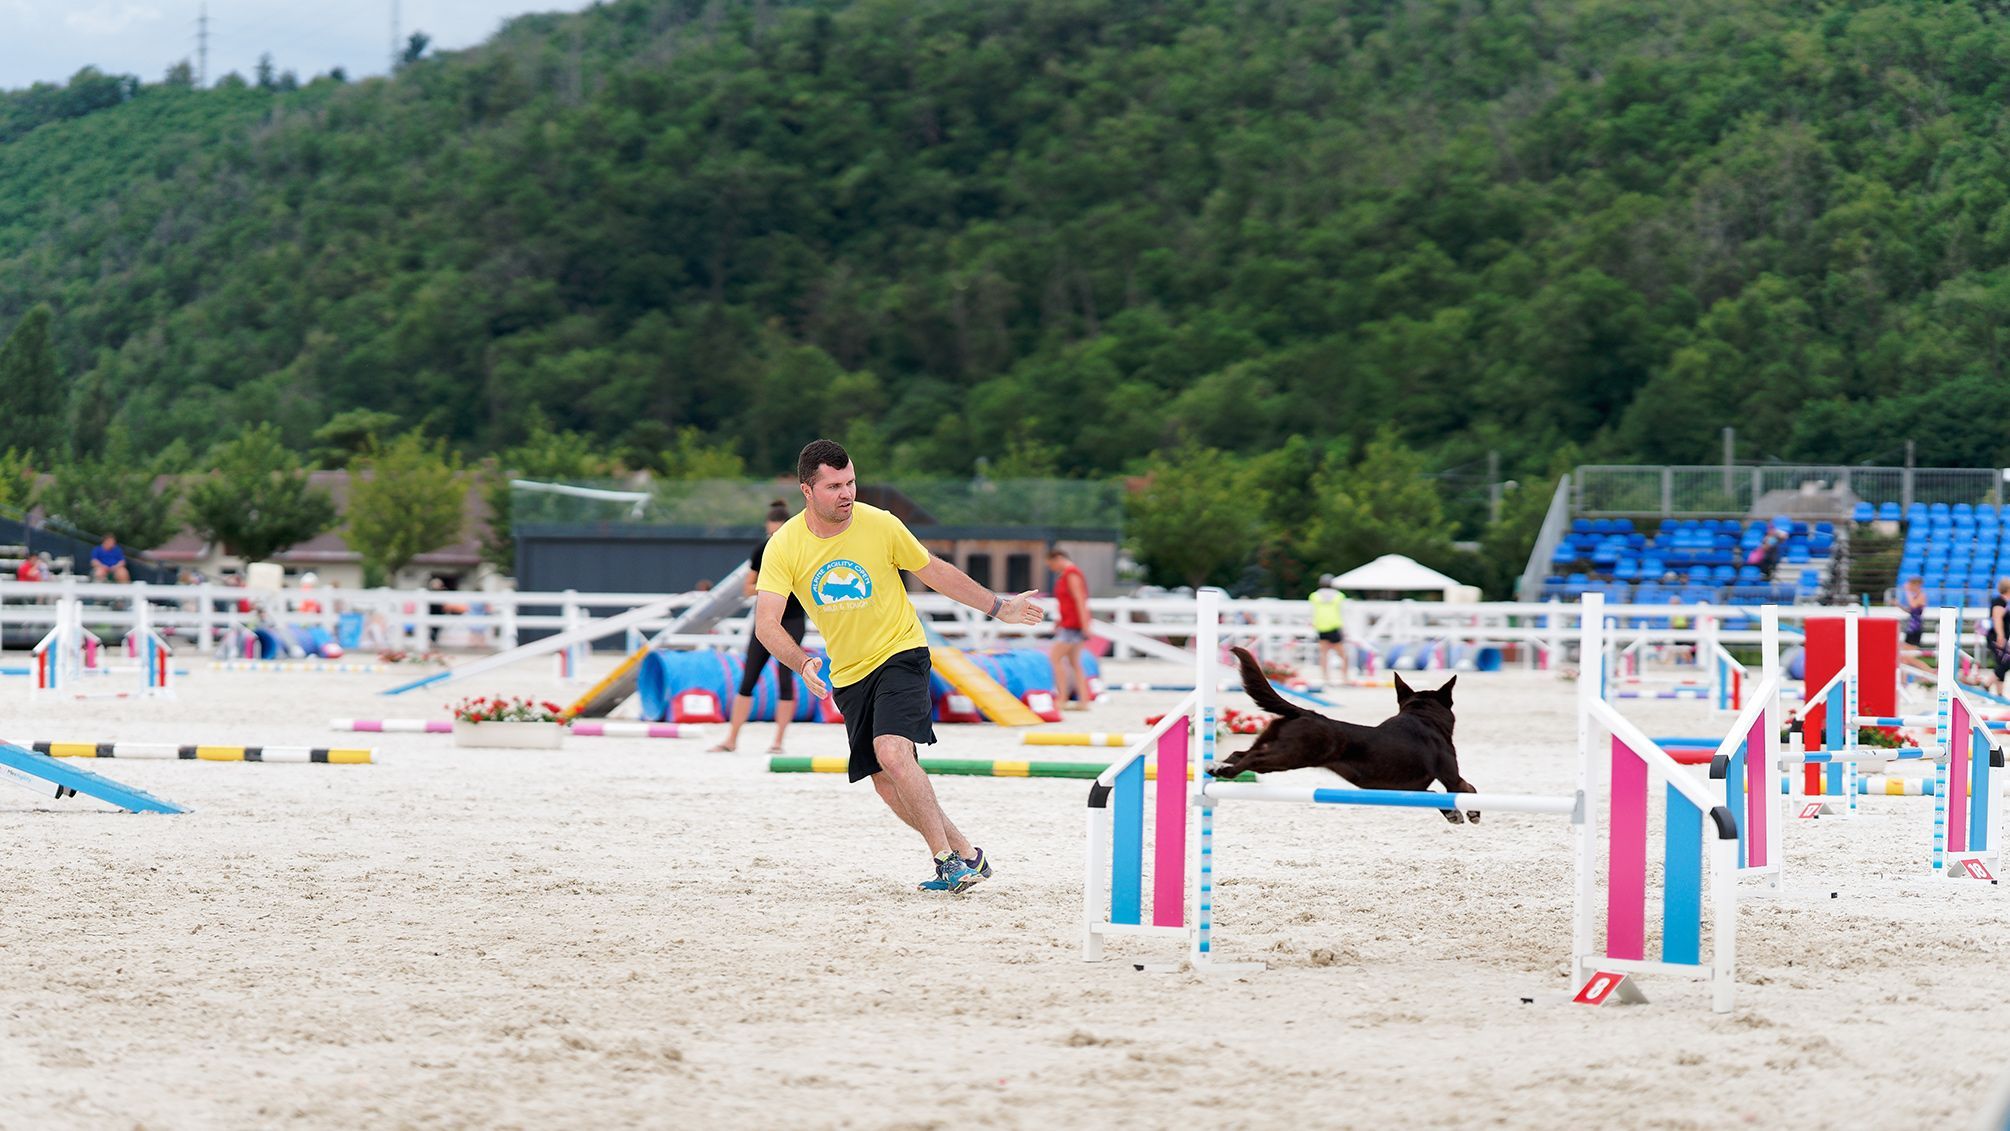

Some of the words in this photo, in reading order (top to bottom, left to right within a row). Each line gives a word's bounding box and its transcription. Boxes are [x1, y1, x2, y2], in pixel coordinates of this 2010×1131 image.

[813, 567, 826, 592] ALPINE
[827, 561, 854, 569] AGILITY
[855, 565, 870, 584] OPEN
[1967, 863, 1987, 878] 18
[1585, 977, 1610, 999] 8
